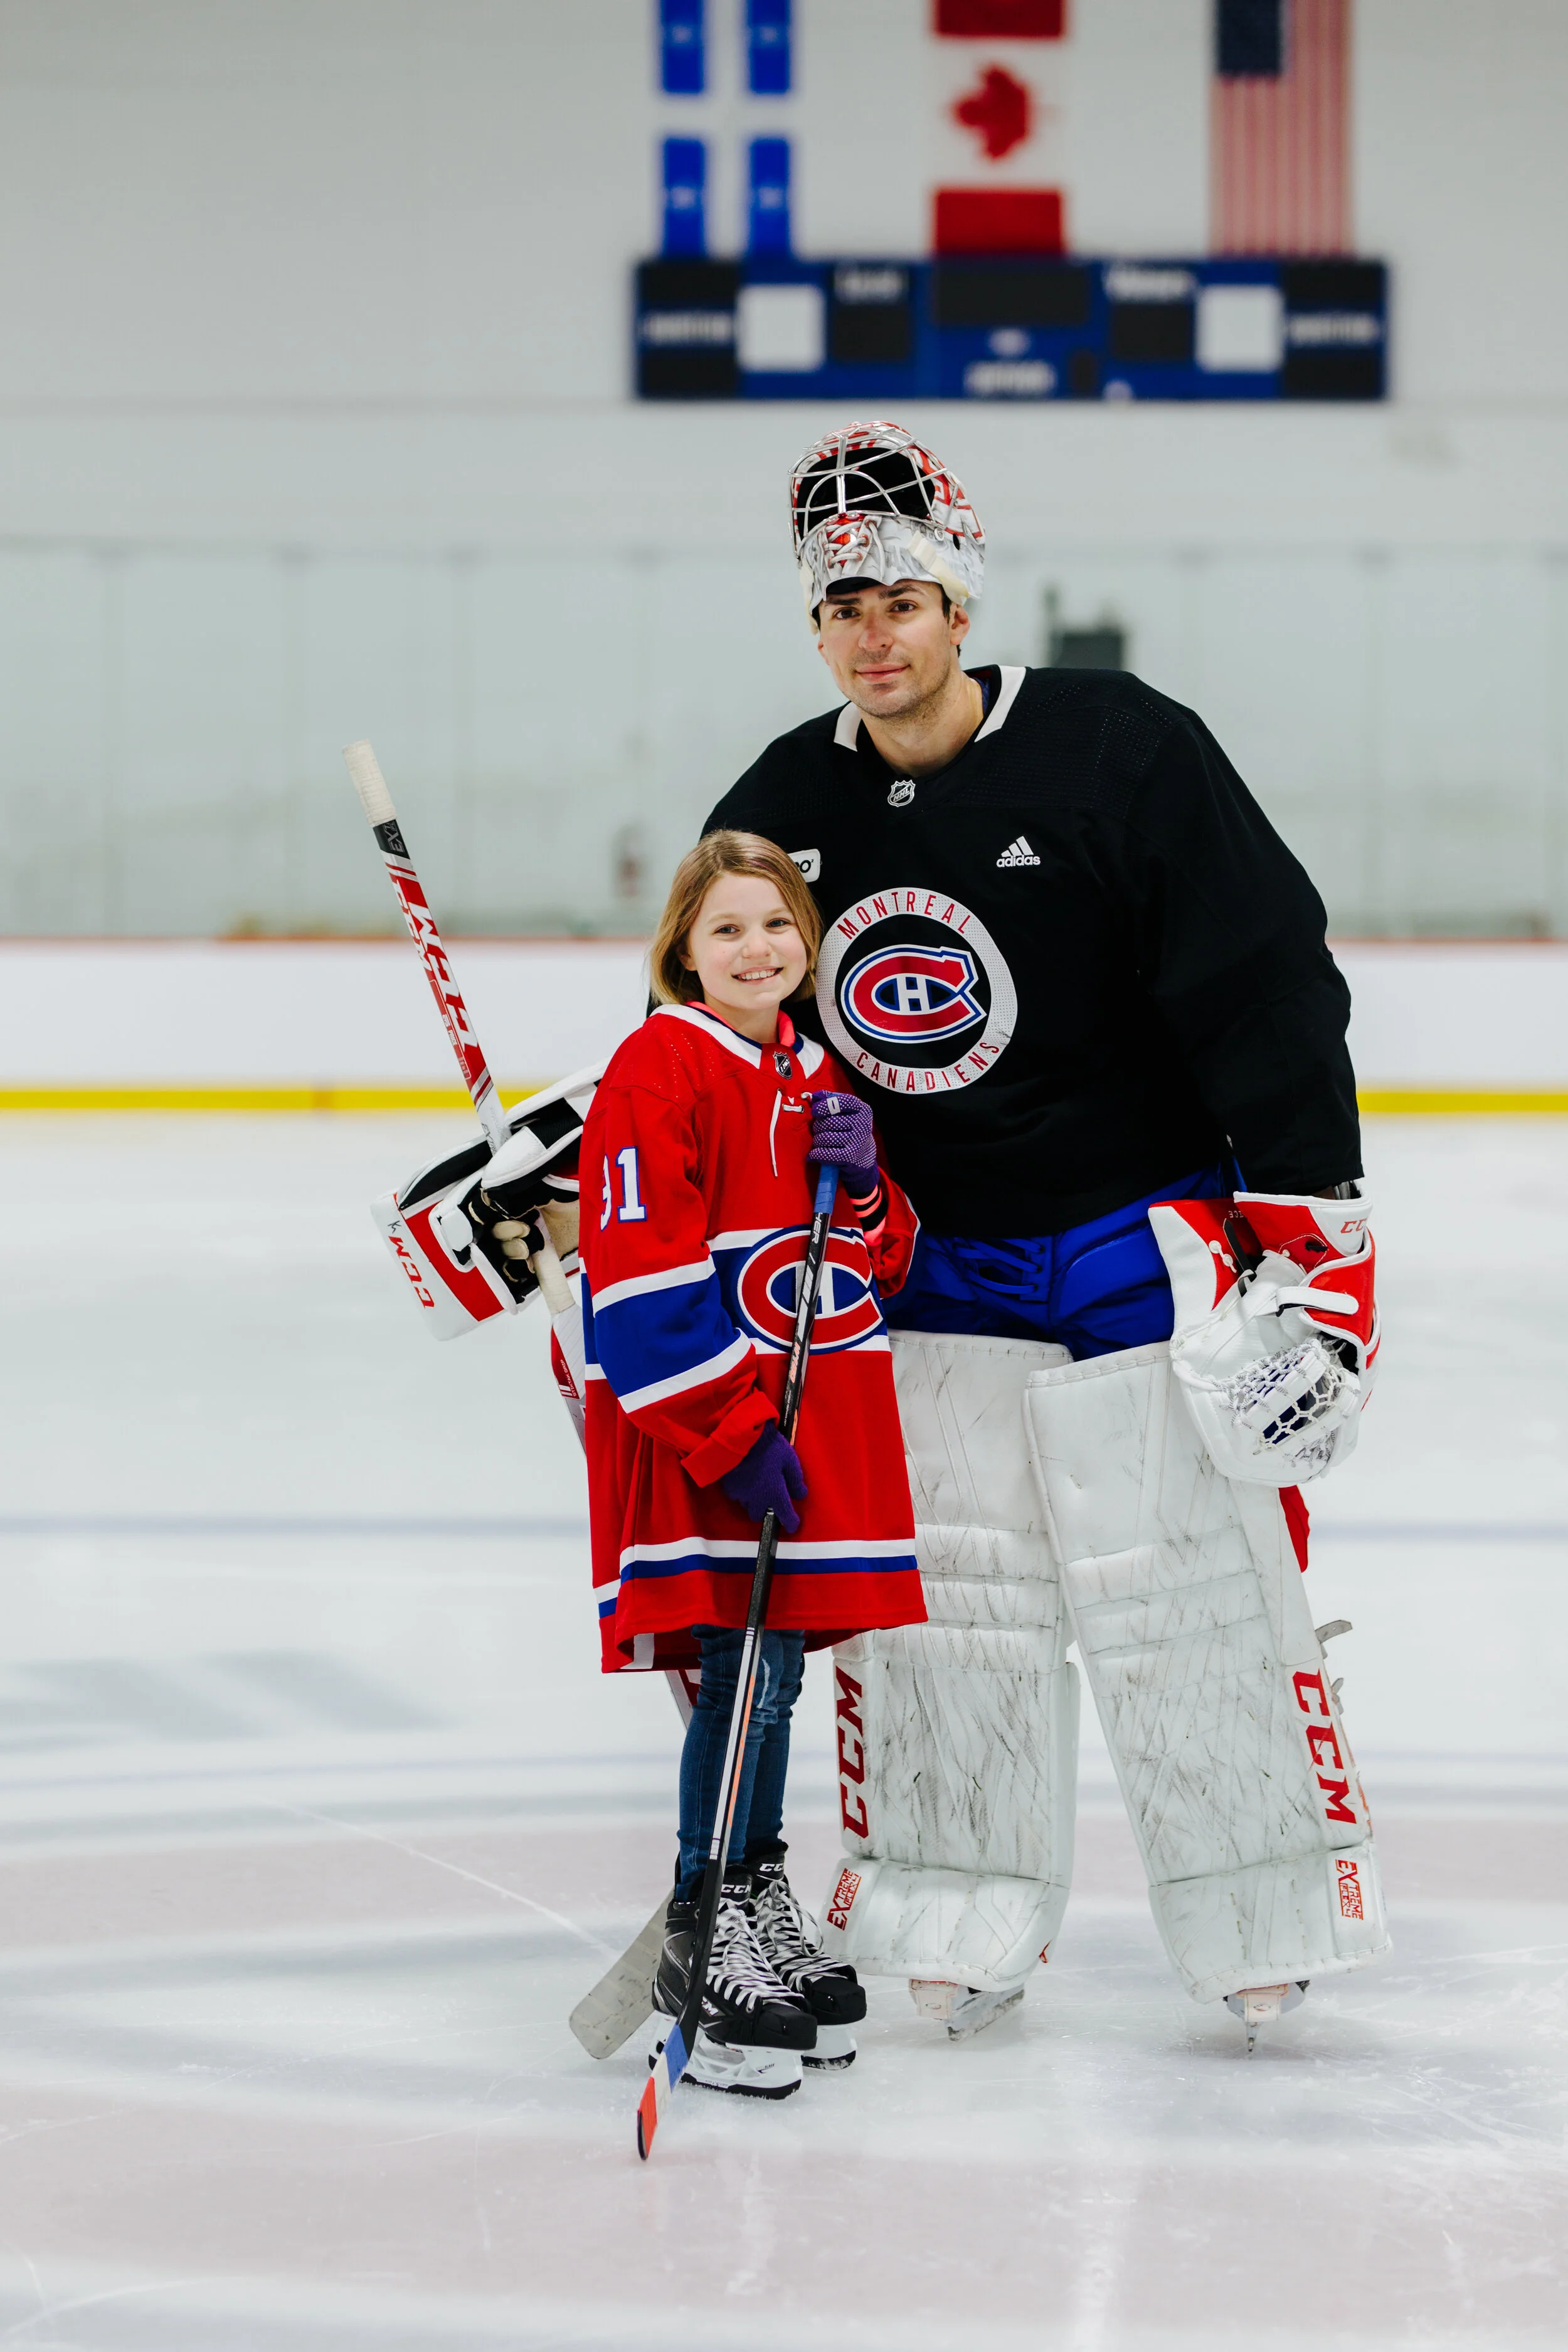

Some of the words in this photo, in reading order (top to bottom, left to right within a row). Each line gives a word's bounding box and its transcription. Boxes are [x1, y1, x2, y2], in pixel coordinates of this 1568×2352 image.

[996, 854, 1041, 867] adidas
[837, 891, 971, 940] MONTREAL
[408, 902, 478, 1054] CCM
[856, 1042, 1000, 1091] CANADIENS
[812, 1212, 823, 1244] HER
[1340, 1217, 1367, 1234] CC
[388, 1236, 435, 1310] CCM
[835, 1665, 869, 1839] CCM
[1292, 1668, 1357, 1825] CCM
[760, 1863, 784, 1872] CC
[1335, 1859, 1364, 1920] EXTREME
[827, 1868, 854, 1931] EXTREME
